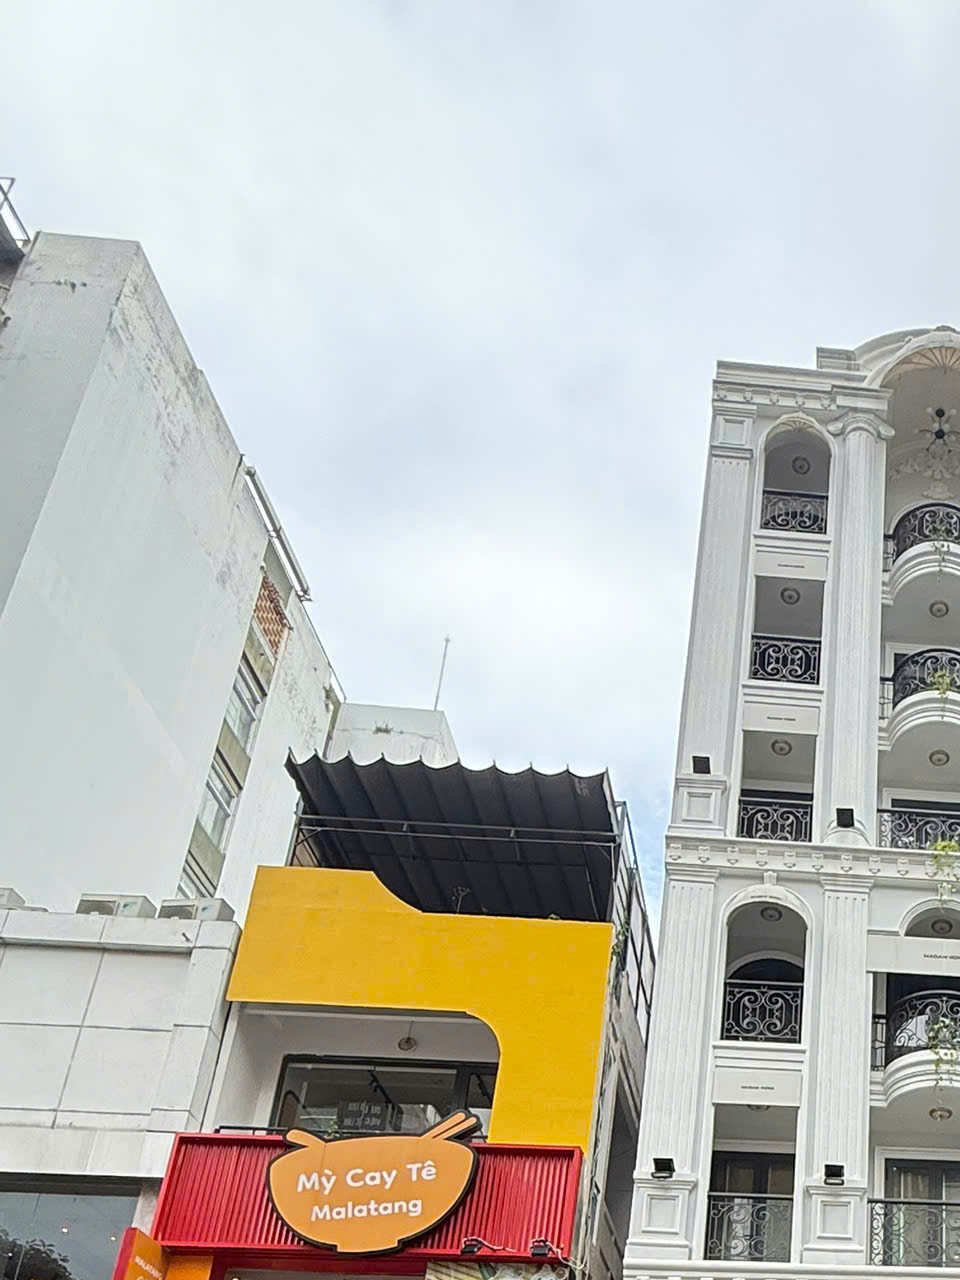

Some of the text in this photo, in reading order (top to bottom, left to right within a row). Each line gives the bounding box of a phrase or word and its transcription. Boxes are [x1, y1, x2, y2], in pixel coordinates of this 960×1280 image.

[296, 1160, 438, 1195] Mỳ Cay Tê
[310, 1198, 423, 1222] Malatang
